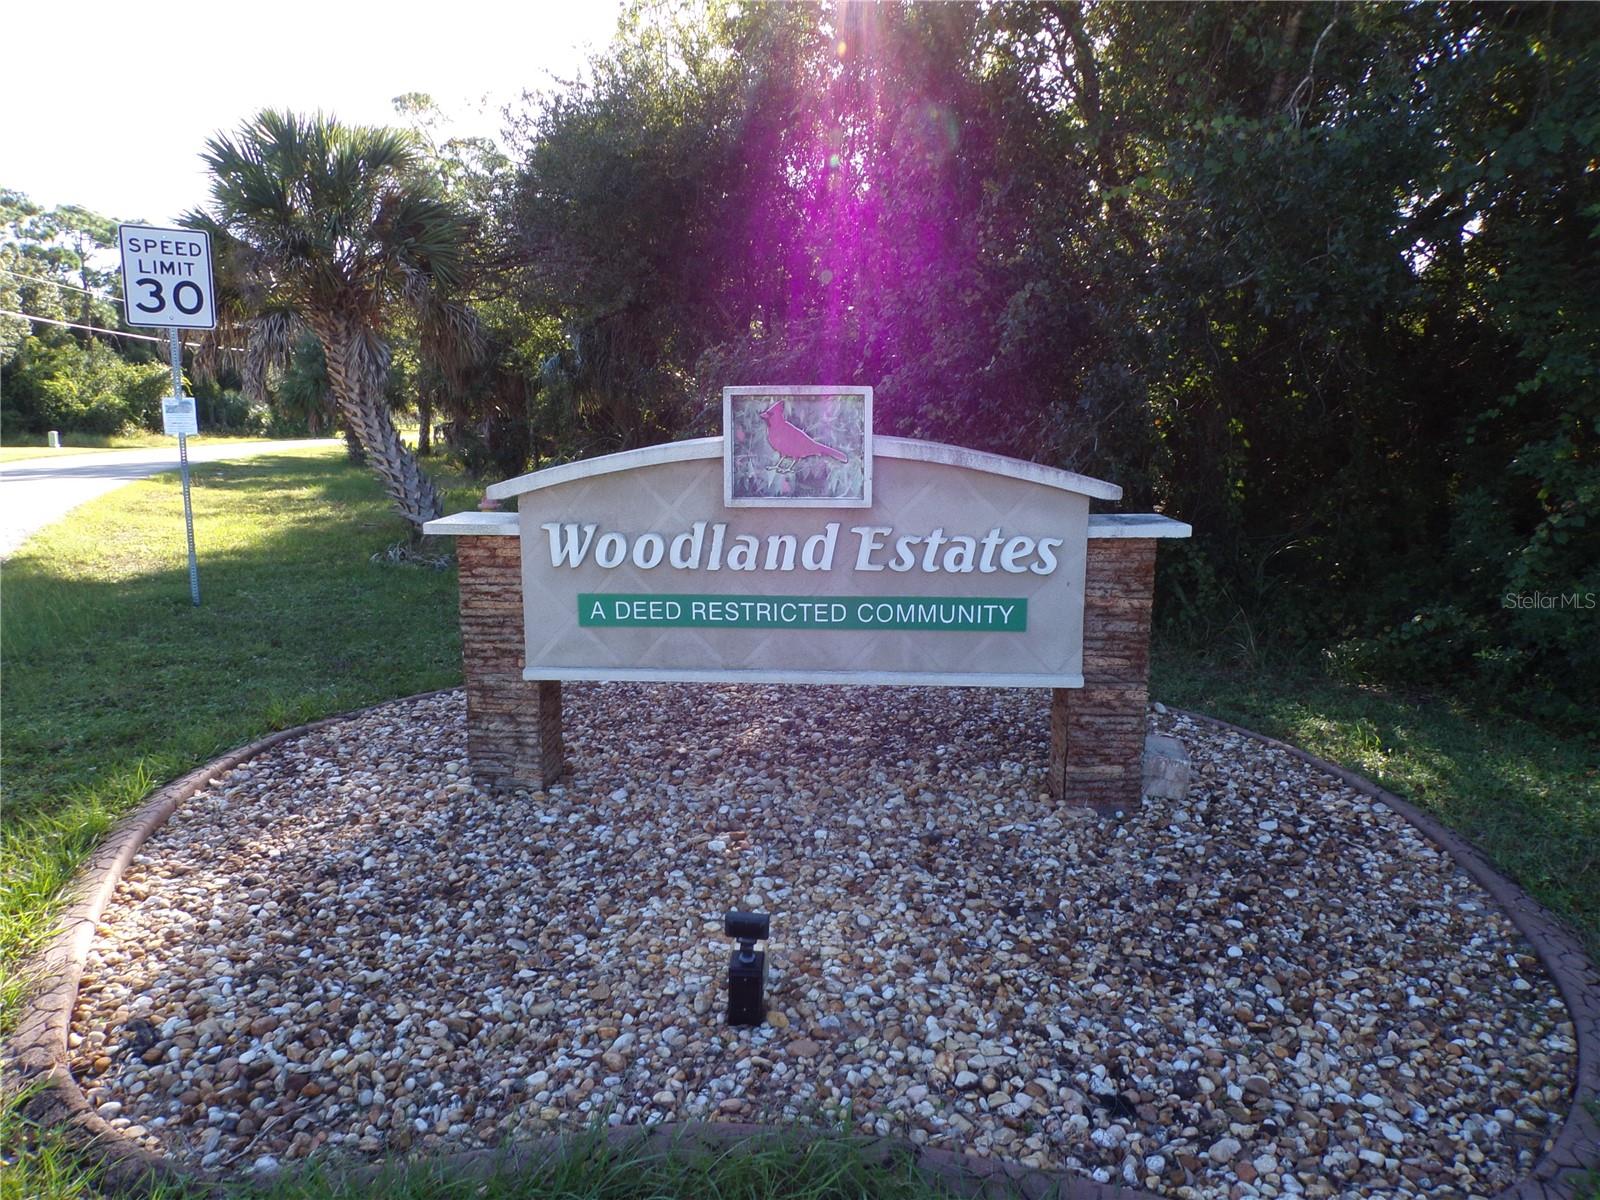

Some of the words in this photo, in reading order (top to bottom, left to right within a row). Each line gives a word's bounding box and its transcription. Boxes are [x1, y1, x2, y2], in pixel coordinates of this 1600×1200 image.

[128, 238, 202, 257] SPEED
[138, 259, 195, 276] LIMIT
[135, 278, 204, 315] 30
[541, 520, 840, 571] Woodland
[851, 526, 1064, 576] Estates
[590, 601, 606, 619] A
[615, 601, 681, 620] DEED
[691, 602, 847, 623] RESTRICTED
[857, 603, 1015, 625] COMMUNITY
